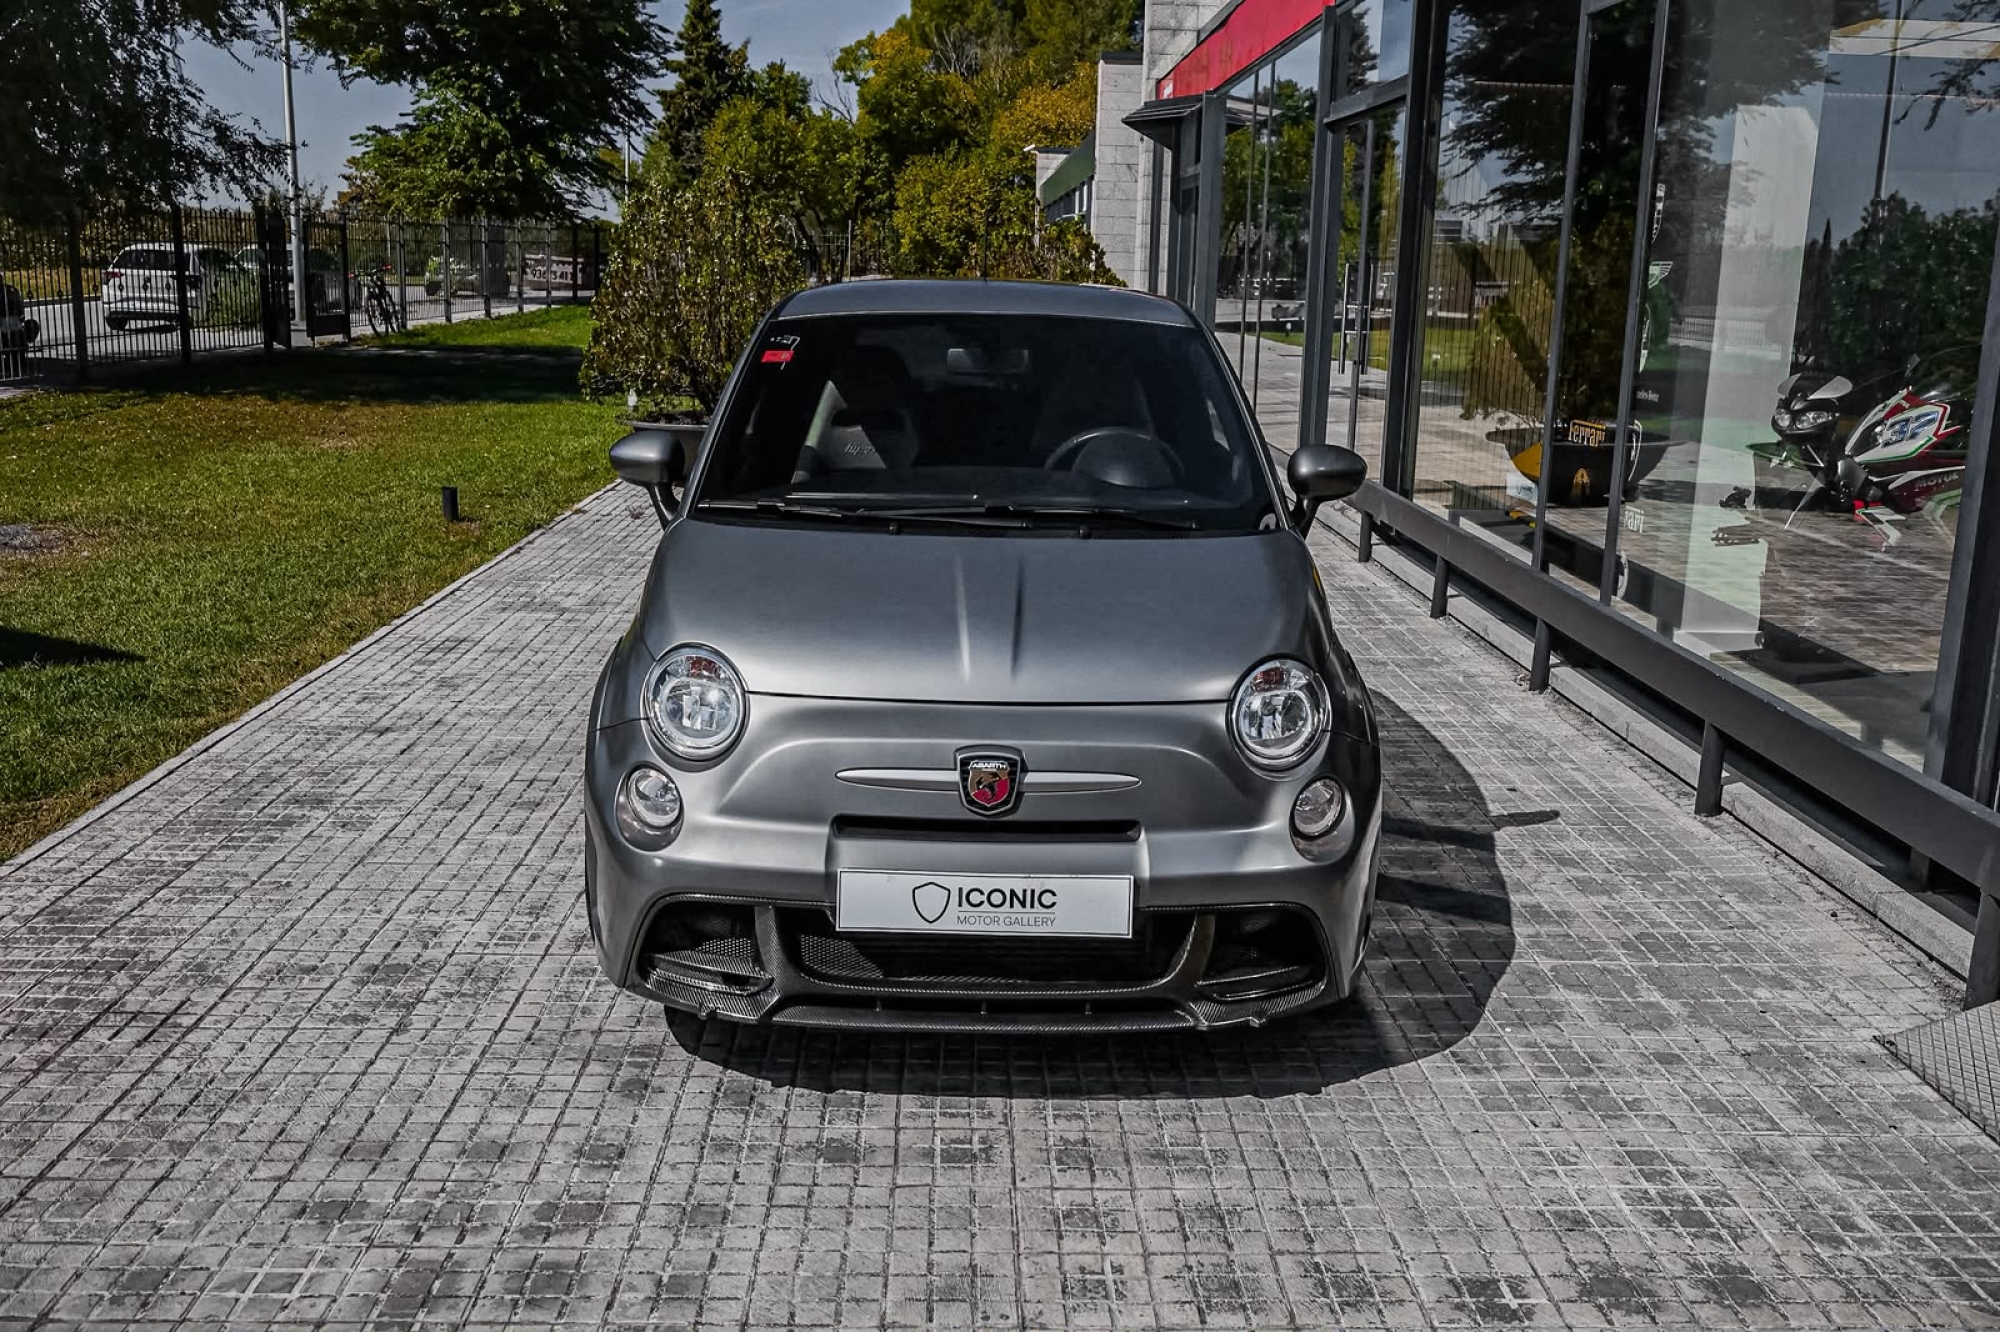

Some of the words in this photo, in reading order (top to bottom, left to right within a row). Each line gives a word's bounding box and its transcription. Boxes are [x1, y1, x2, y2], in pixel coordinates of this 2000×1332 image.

[958, 887, 1057, 909] ICONIC
[957, 915, 1000, 926] MOTOR
[1003, 916, 1056, 927] GALLERY
